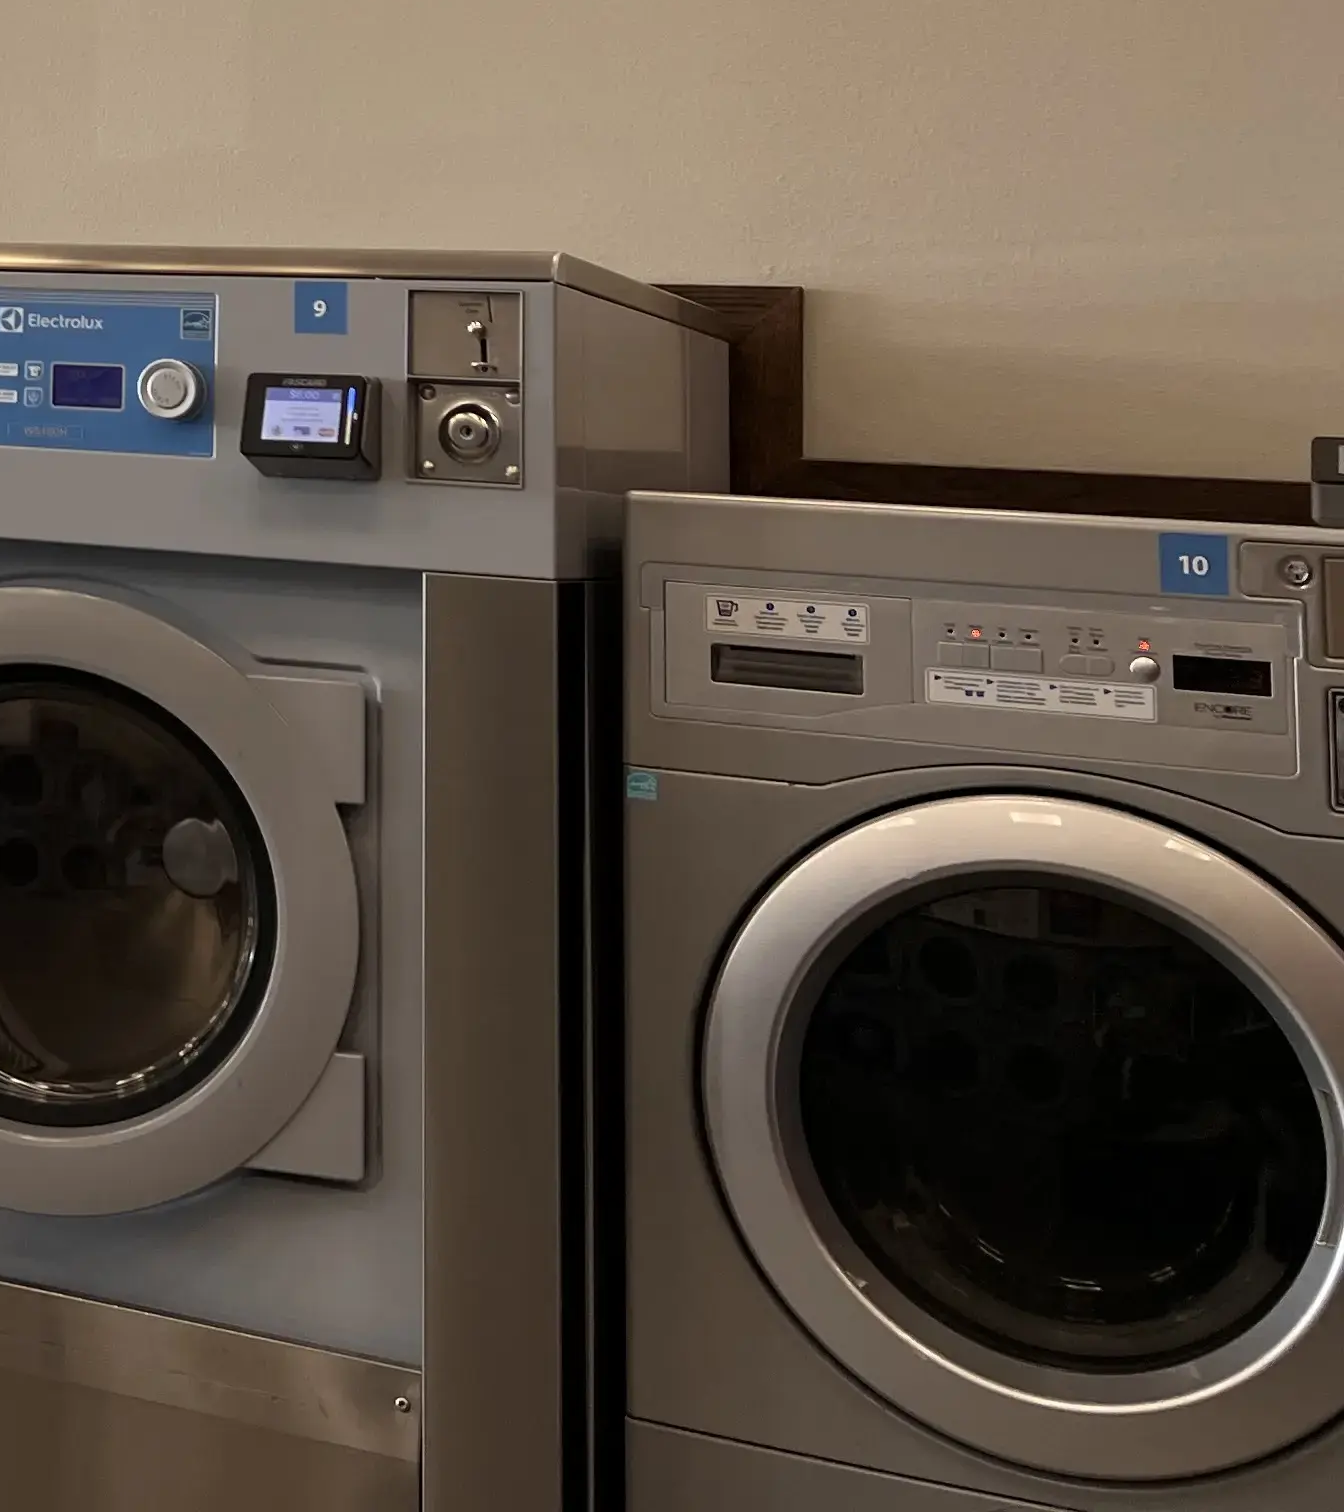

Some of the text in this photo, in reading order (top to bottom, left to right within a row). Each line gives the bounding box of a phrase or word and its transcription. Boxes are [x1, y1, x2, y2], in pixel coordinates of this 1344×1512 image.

[313, 300, 327, 317] 9
[27, 313, 104, 330] Electrolux
[1178, 555, 1209, 576] 10
[1194, 702, 1253, 716] ENCORE
